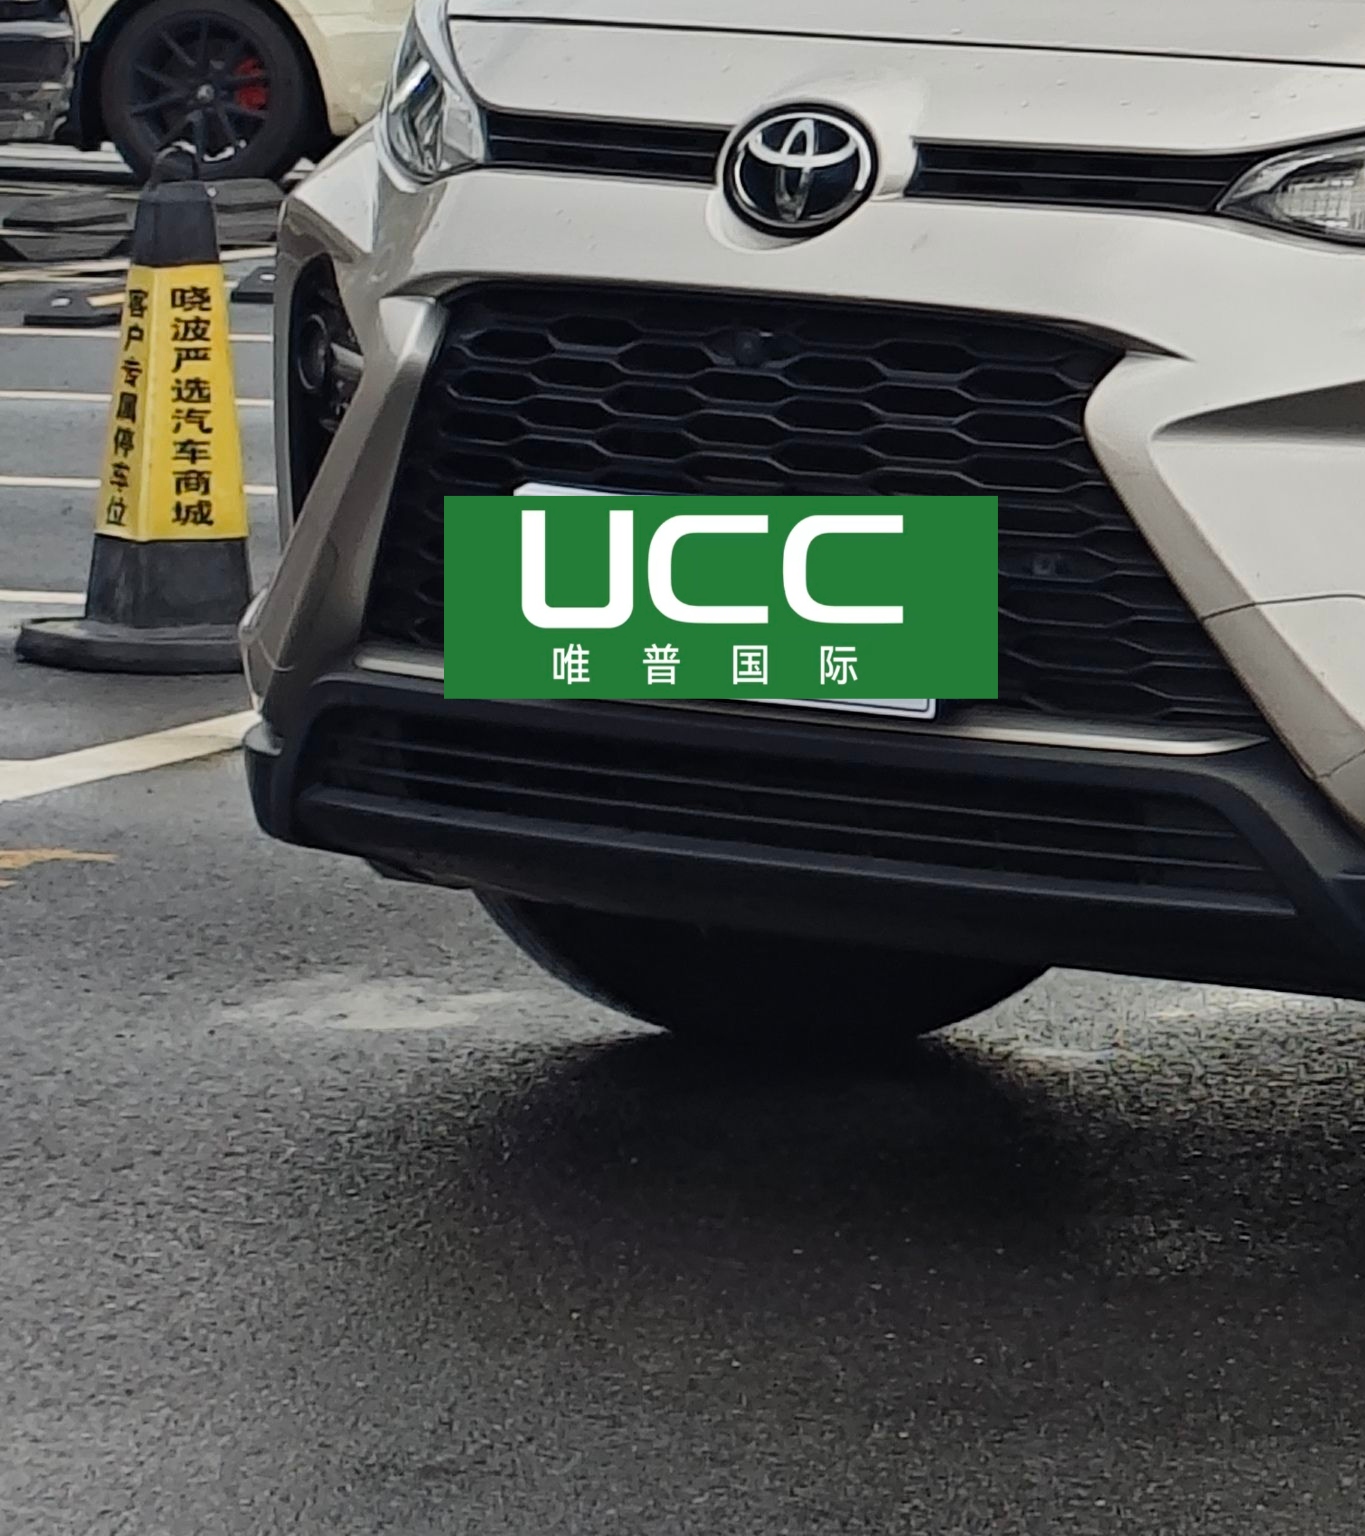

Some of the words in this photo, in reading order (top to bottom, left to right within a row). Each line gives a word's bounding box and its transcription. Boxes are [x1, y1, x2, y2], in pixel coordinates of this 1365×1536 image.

[106, 289, 148, 526] 客户专属停车位
[170, 286, 214, 527] 晓波严选汽车商城
